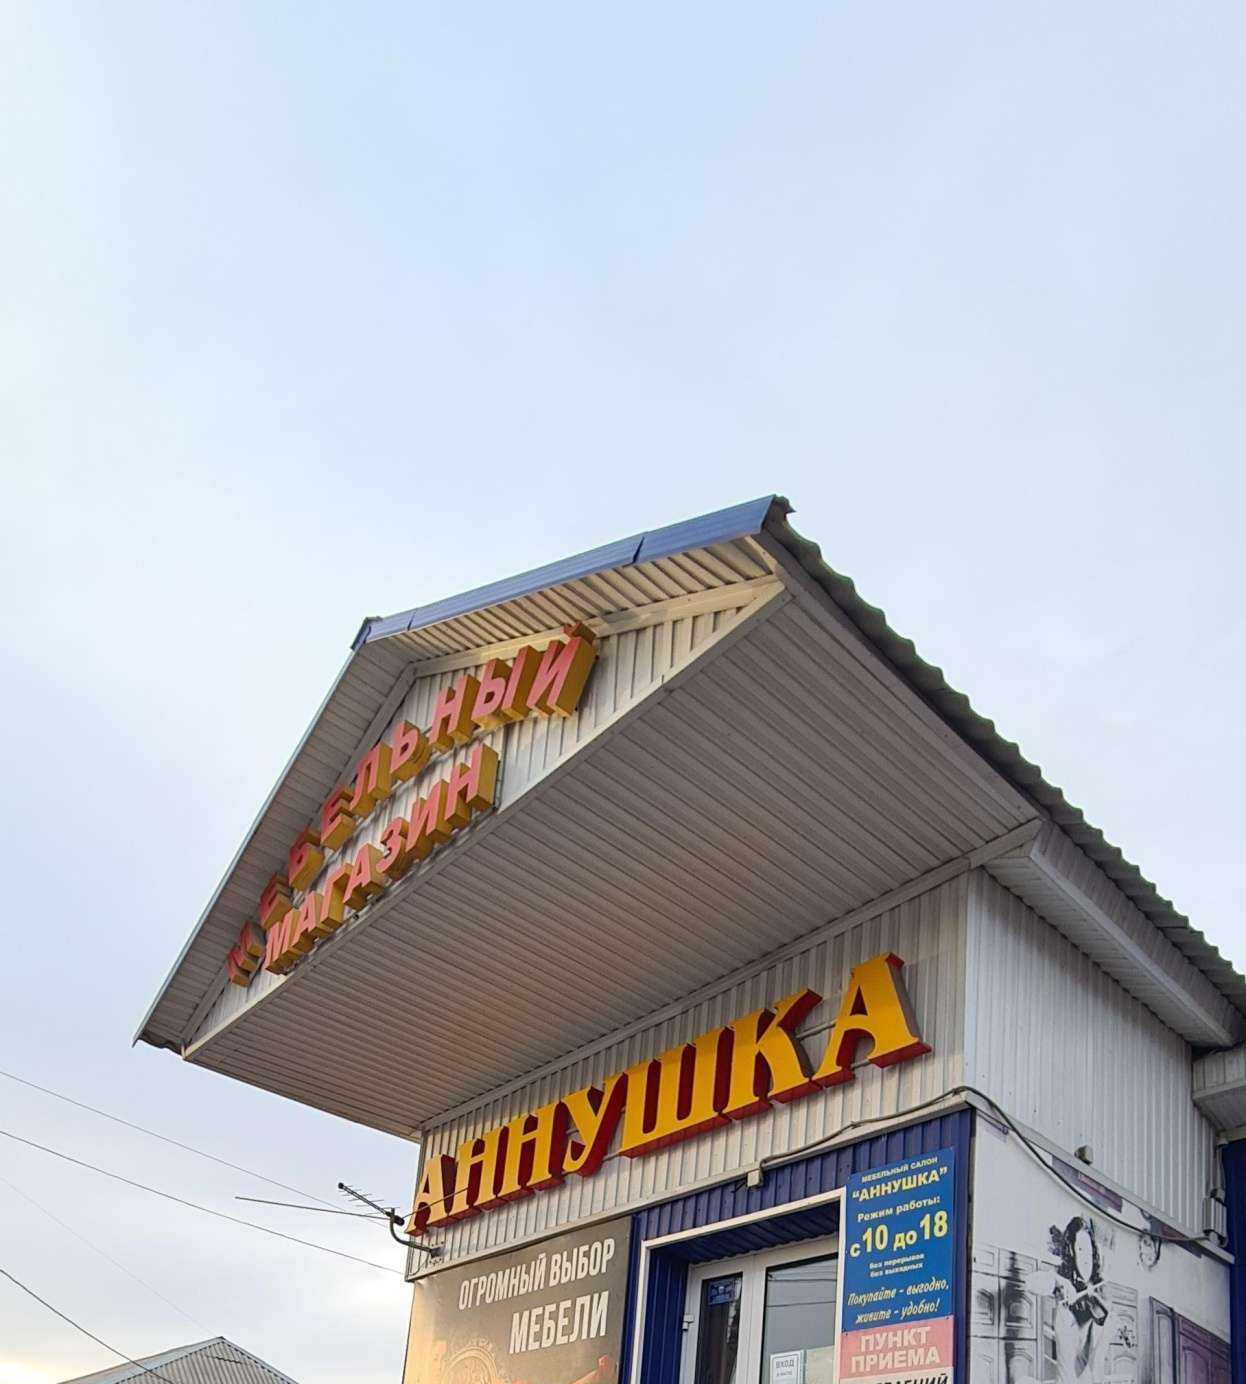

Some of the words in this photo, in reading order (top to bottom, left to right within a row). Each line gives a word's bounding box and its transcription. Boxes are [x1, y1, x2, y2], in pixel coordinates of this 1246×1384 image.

[226, 621, 600, 987] МЕБЕЛЬНЫЙ
[264, 742, 499, 976] МАГАЗИН
[404, 951, 932, 1236] АННУШКА
[862, 1164, 909, 1183] МЕБЕЛЬНЫЙ
[910, 1157, 938, 1170] САЛОН
[857, 1207, 894, 1223] Режим
[896, 1196, 941, 1215] работы:
[862, 1224, 889, 1253] 10
[892, 1230, 918, 1252] до
[919, 1210, 948, 1240] 18
[458, 1252, 546, 1310] ОГРОМНЫЙ
[549, 1238, 615, 1287] ВЫБОР
[869, 1262, 883, 1270] без
[870, 1270, 883, 1278] без
[884, 1263, 924, 1275] выходных
[847, 1286, 897, 1307] Покупайте
[906, 1276, 949, 1296] выгодно,
[509, 1290, 609, 1354] МЕБЕЛИ
[856, 1309, 891, 1324] живите
[901, 1298, 940, 1320] удобно!
[860, 1326, 932, 1353] ПУНКТ
[851, 1346, 940, 1373] ПРИЕМА
